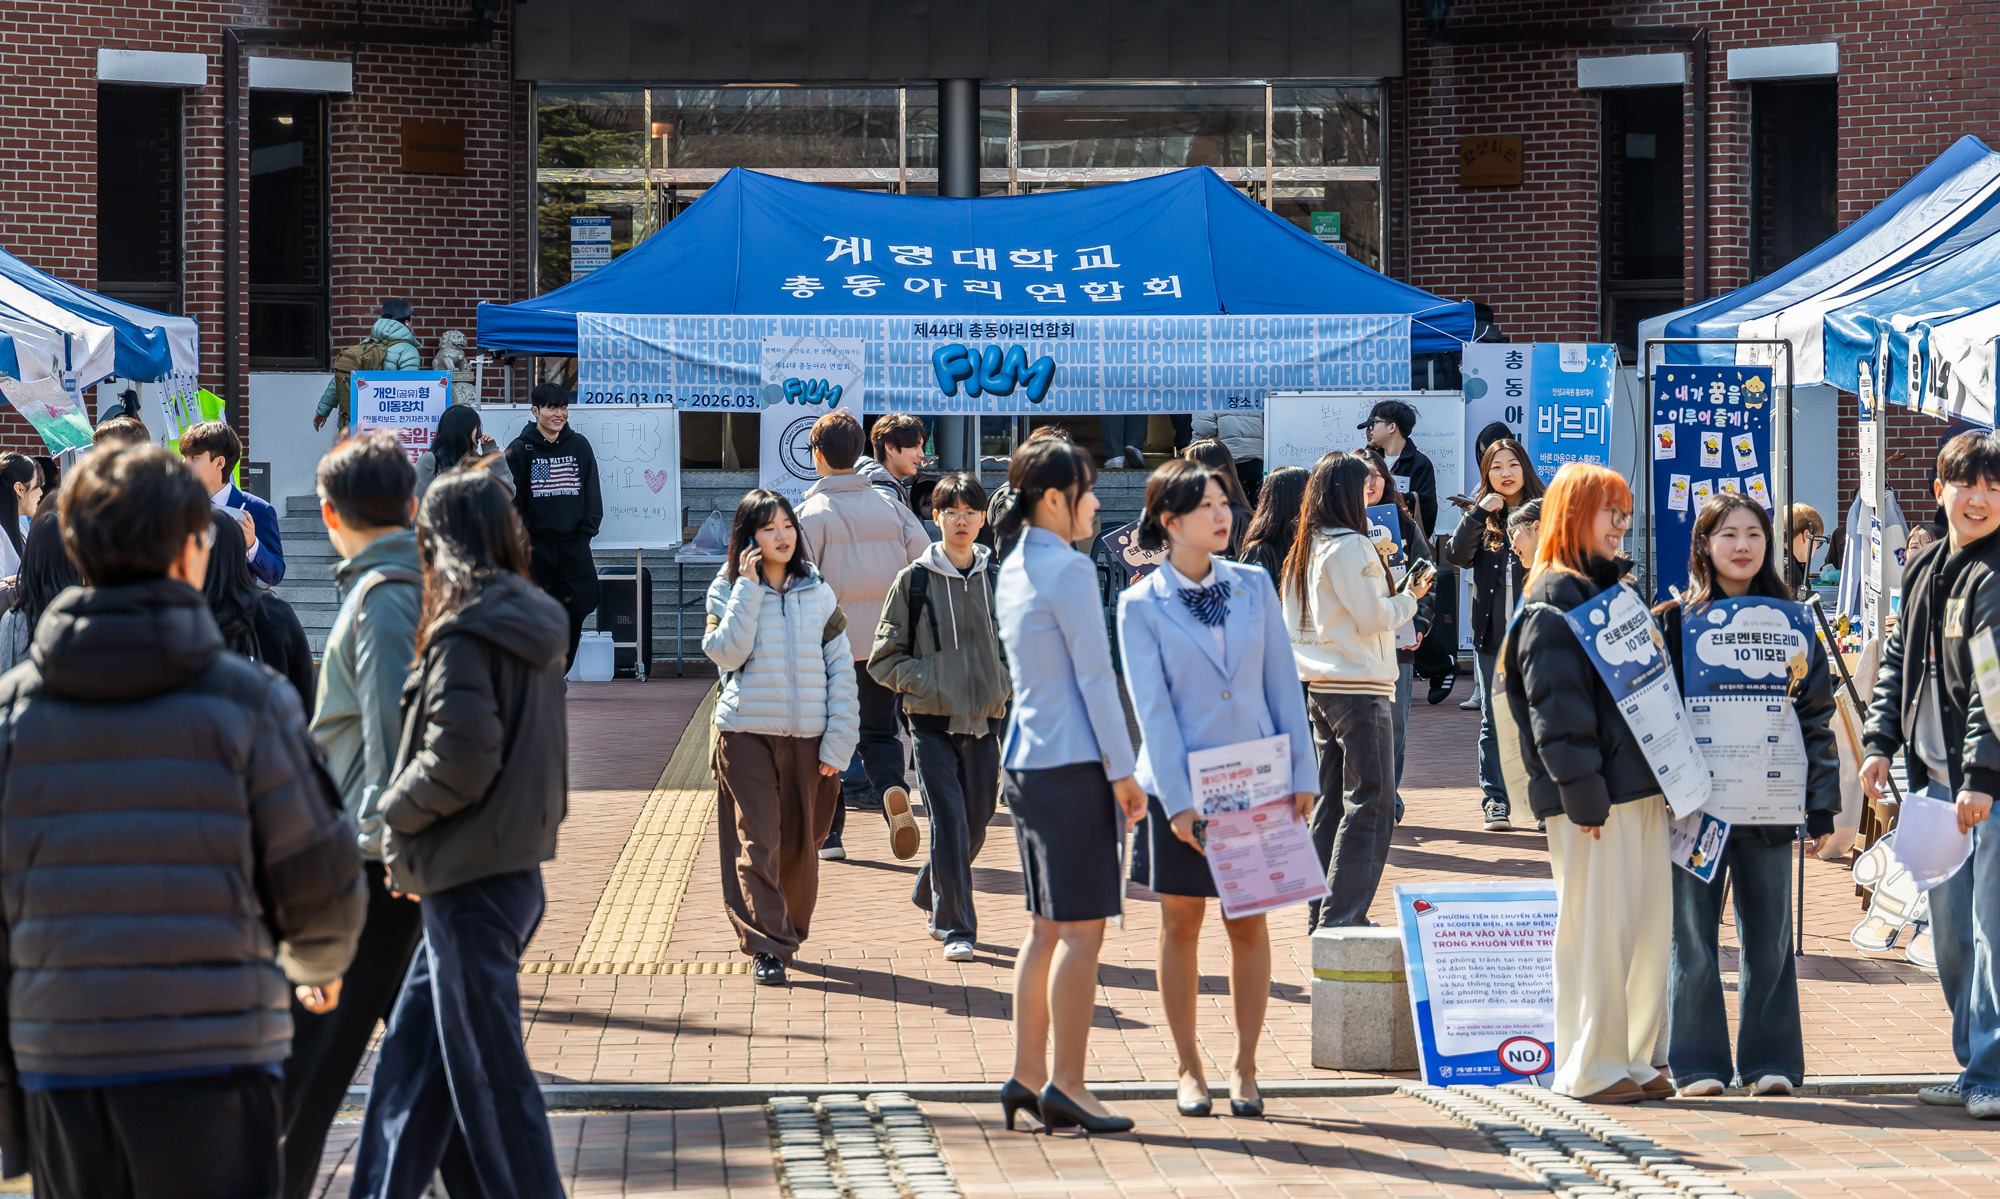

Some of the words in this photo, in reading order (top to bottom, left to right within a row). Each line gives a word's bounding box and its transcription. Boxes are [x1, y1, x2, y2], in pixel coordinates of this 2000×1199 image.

[823, 235, 1121, 272] 계명대학교
[781, 275, 1183, 303] 총동아리연합회
[674, 318, 777, 340] WELCOME
[781, 318, 885, 340] WELCOME
[1103, 318, 1207, 340] WELCOME
[1210, 318, 1314, 340] WELCOME
[914, 322, 963, 338] 제44대
[968, 322, 1075, 338] 총동아리연합회
[1103, 342, 1207, 364] WELCOME
[1210, 341, 1314, 364] WELCOME
[799, 362, 827, 370] 총동아리
[829, 362, 850, 370] 연합회
[932, 343, 1056, 404] FILM
[1103, 366, 1207, 388] WELCOME
[1210, 365, 1314, 387] WELCOME
[783, 377, 843, 409] FILM
[1103, 389, 1207, 411] WELCOME
[1552, 388, 1575, 397] 인성교육원
[1576, 388, 1594, 397] 홍보대사
[1675, 385, 1703, 402] 내가
[1708, 381, 1741, 405] 꿈을
[379, 400, 424, 412] 이동장치
[1227, 397, 1252, 409] 장소
[399, 415, 430, 423] 전기자전거
[1321, 403, 1344, 429] 본부
[1668, 407, 1711, 426] 이루어
[1713, 408, 1749, 430] 줄게!
[1537, 402, 1606, 446] 바르미
[601, 422, 647, 455] 티켓
[785, 421, 804, 445] KEIMYUNG
[549, 456, 574, 464] MATTER
[1540, 453, 1553, 464] 바른
[616, 615, 632, 625] JBL
[1710, 632, 1799, 647] 진로멘토단드리미
[1733, 648, 1787, 662] 10기모집
[1475, 929, 1495, 937] VÀO
[1498, 929, 1511, 937] VÀ
[1432, 940, 1468, 948] TRONG
[1471, 939, 1507, 947] KHUÔN
[1510, 939, 1533, 947] VIÊN
[1450, 957, 1476, 965] phòng
[1493, 980, 1516, 989] trong
[1508, 1049, 1542, 1063] NO!
